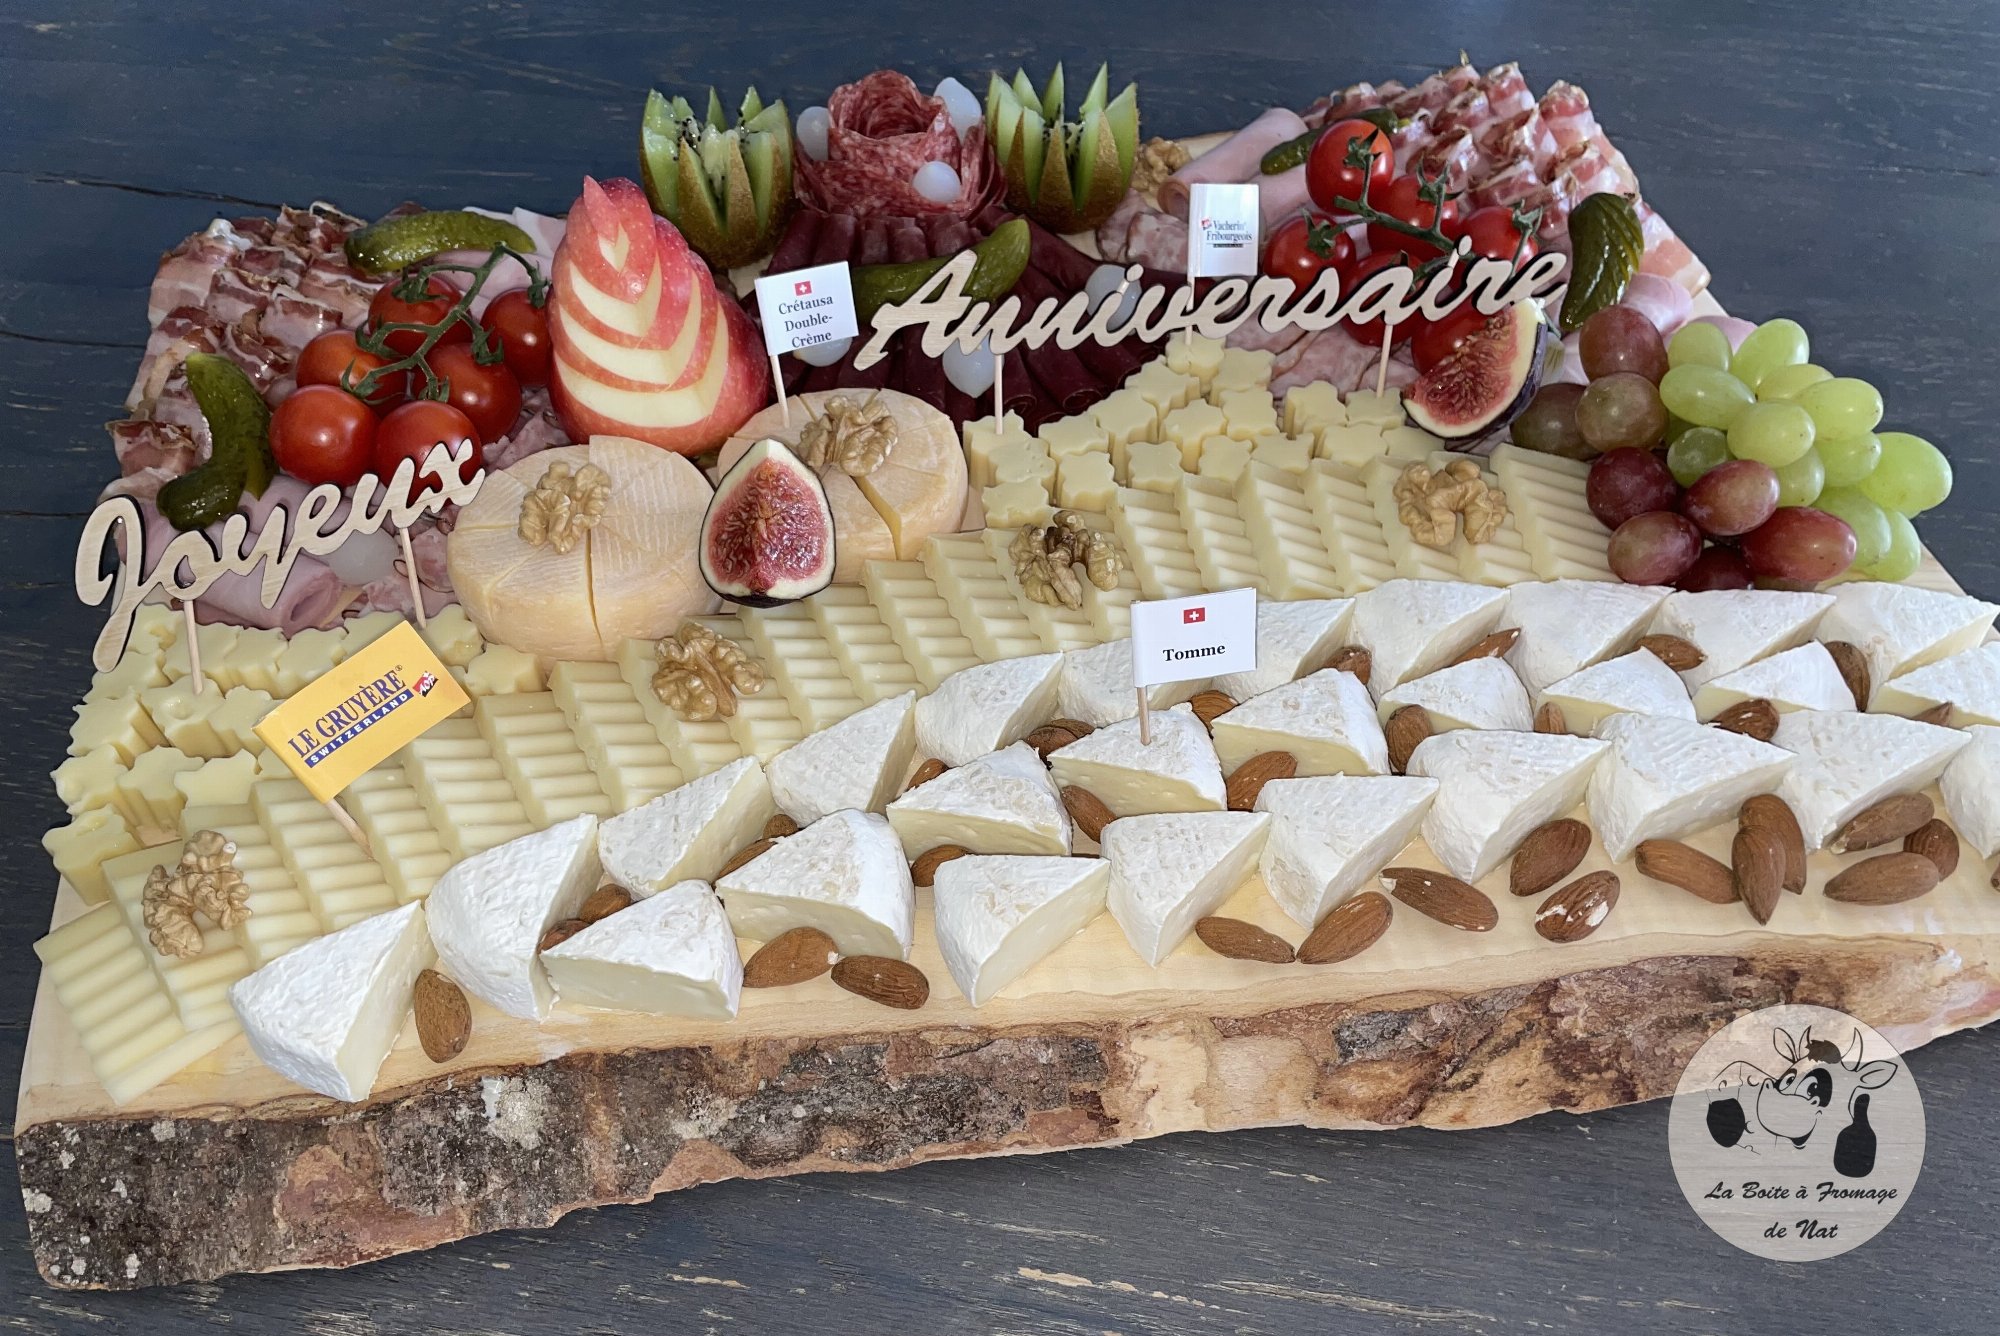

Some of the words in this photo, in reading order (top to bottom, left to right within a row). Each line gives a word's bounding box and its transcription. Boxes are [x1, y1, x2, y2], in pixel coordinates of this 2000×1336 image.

[1206, 230, 1253, 243] Fribourgeois
[778, 295, 834, 315] Crétausa
[853, 236, 1566, 371] Anniversaire
[784, 312, 833, 332] Double-
[791, 331, 832, 348] Crème
[75, 438, 486, 672] Joyeux
[1162, 644, 1226, 661] Tomme
[310, 692, 409, 764] SWITZERLAND
[287, 728, 321, 758] LE
